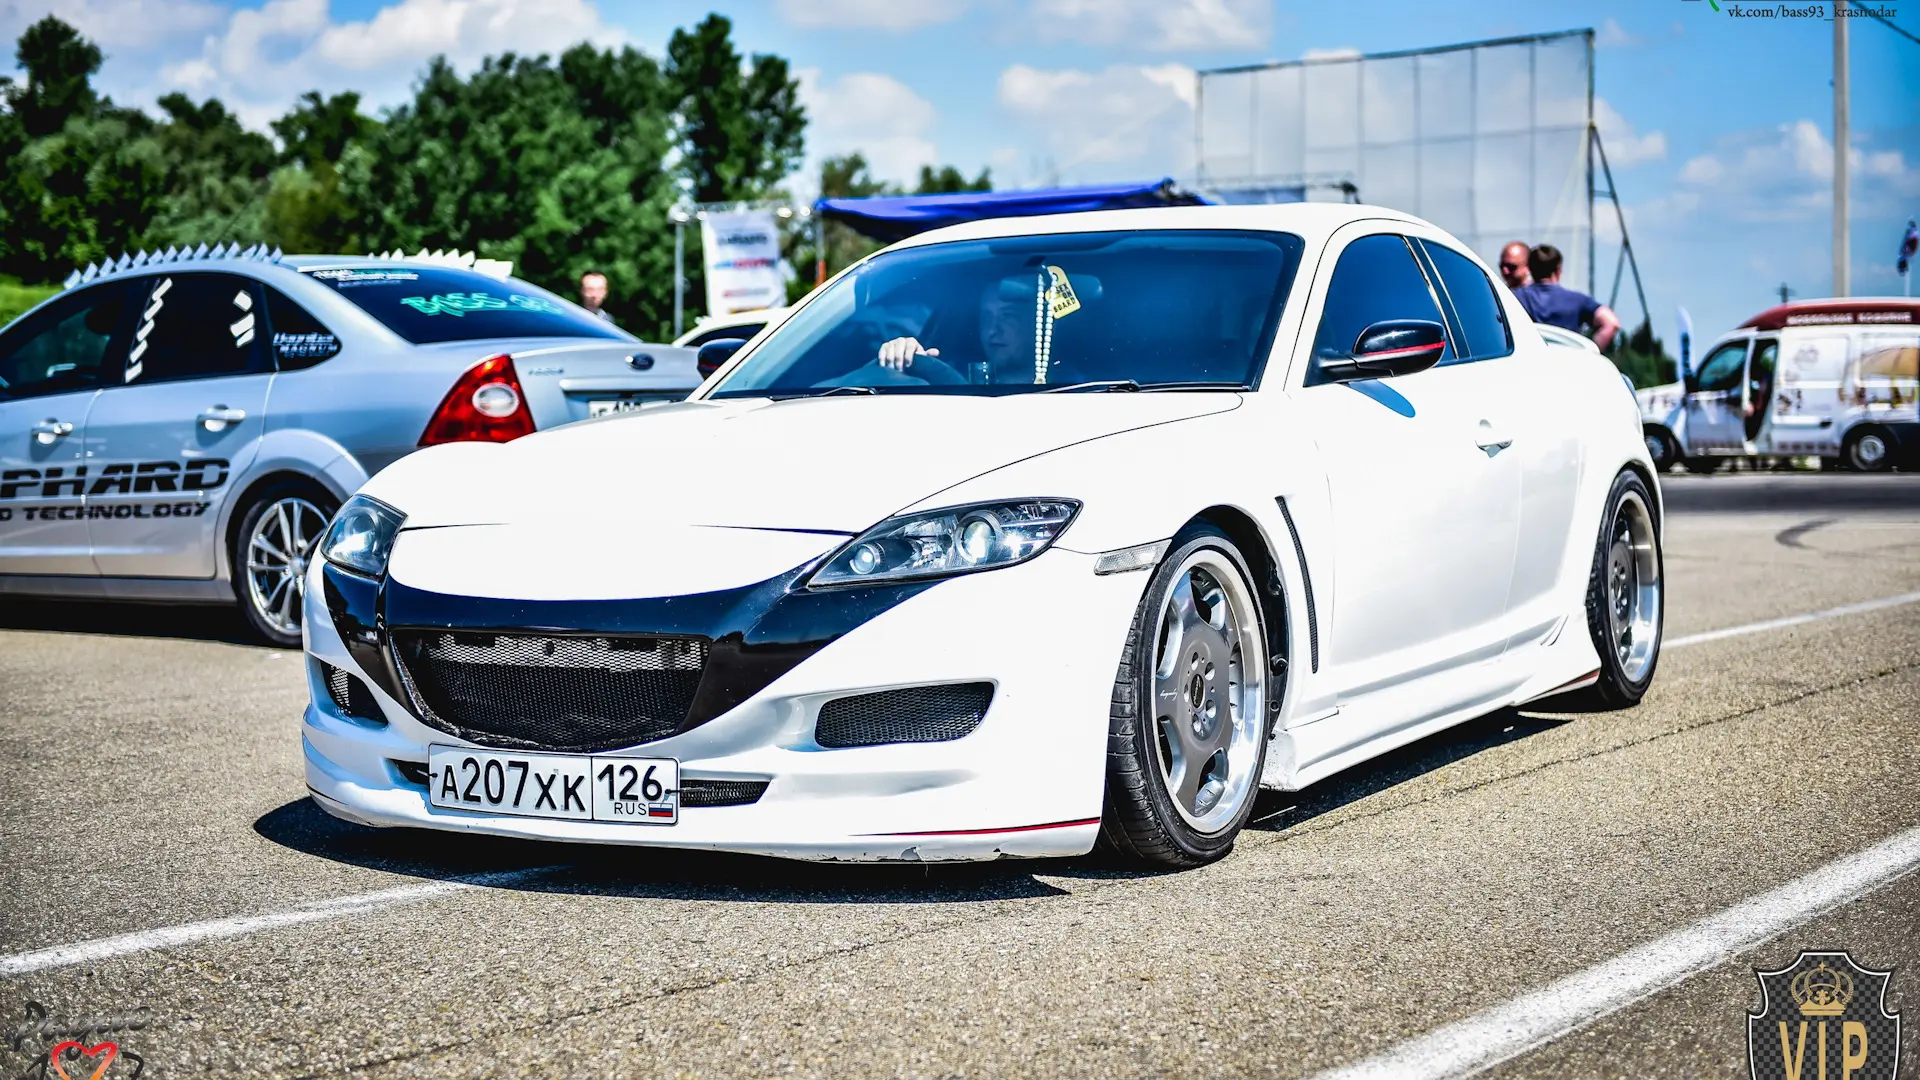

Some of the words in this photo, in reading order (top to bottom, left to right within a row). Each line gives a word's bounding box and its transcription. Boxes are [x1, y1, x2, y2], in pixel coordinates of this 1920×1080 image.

[1053, 297, 1076, 313] BOARD
[23, 501, 212, 521] TECHNOLOGY
[440, 756, 586, 813] A207XK
[597, 764, 664, 801] 126
[614, 802, 648, 816] RUS
